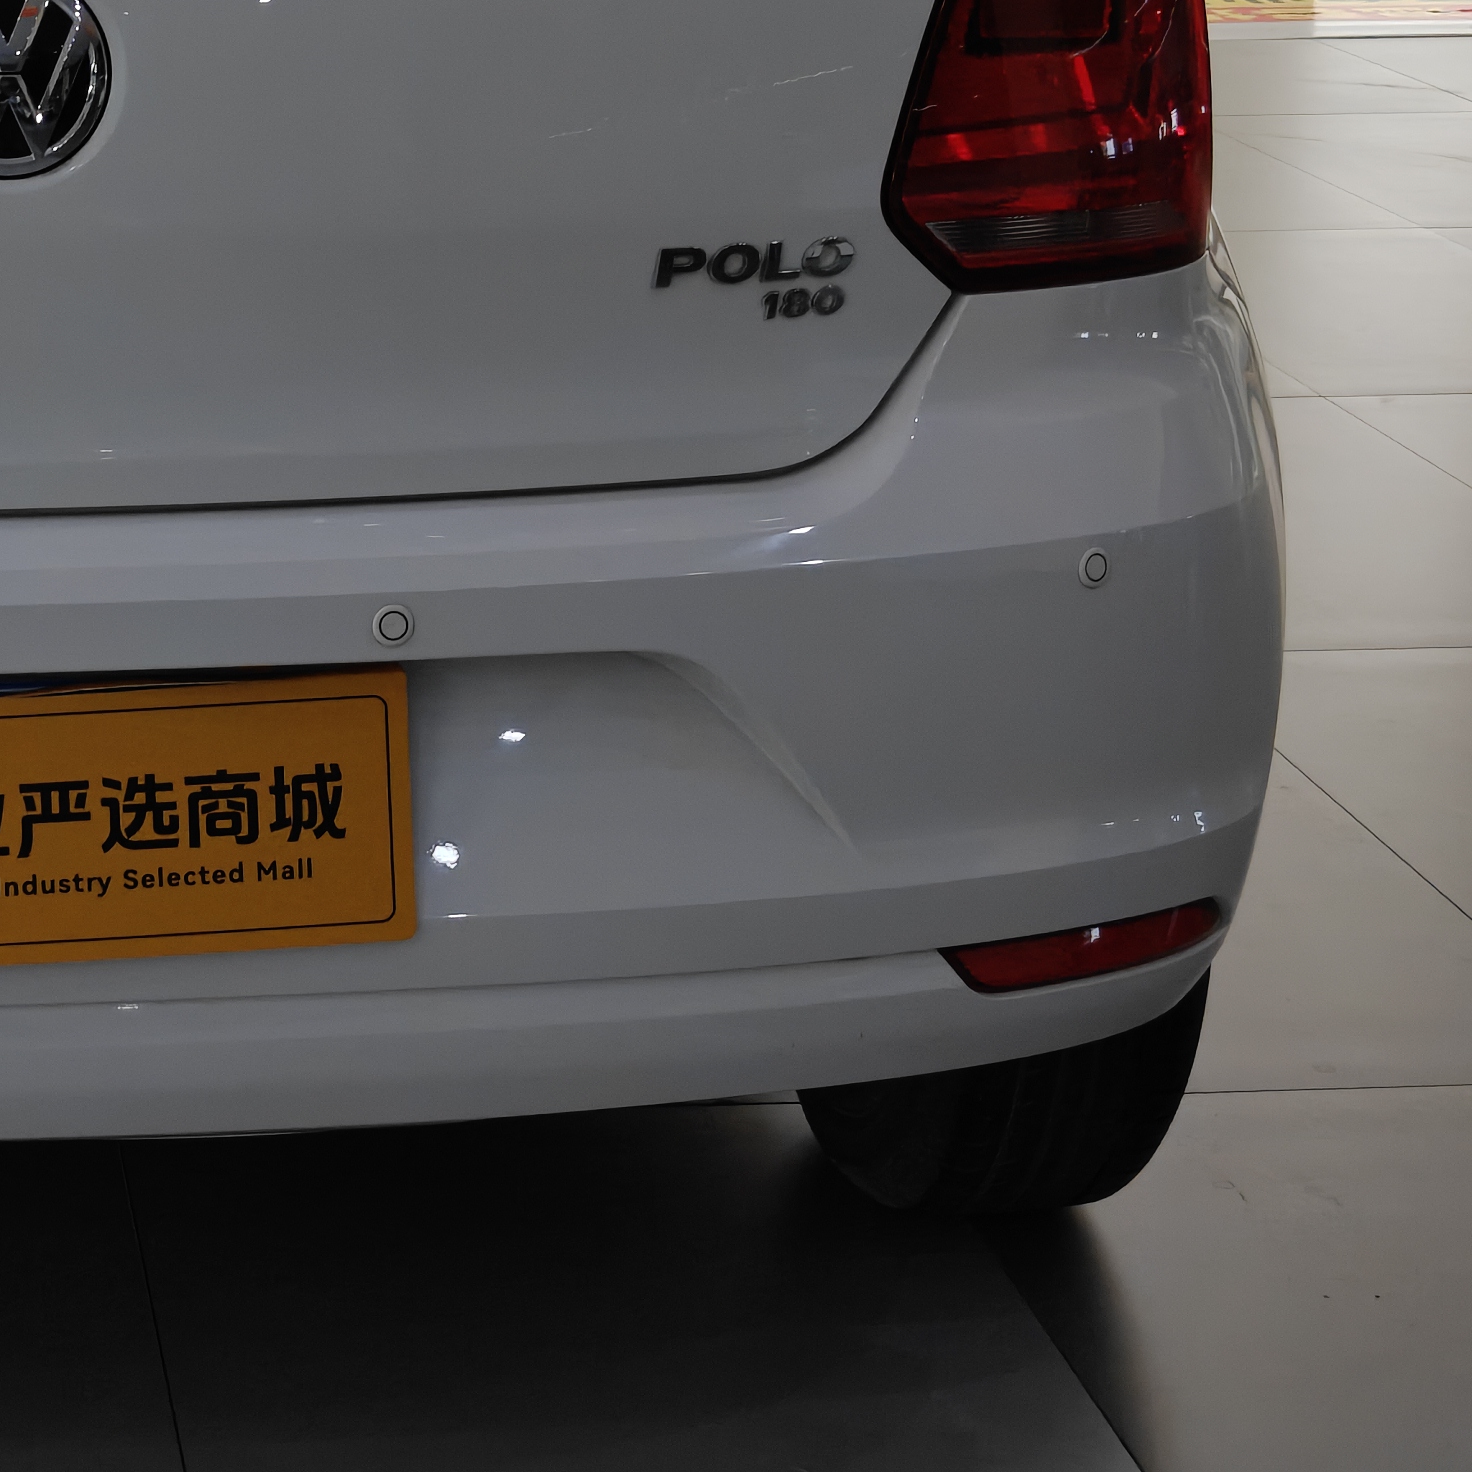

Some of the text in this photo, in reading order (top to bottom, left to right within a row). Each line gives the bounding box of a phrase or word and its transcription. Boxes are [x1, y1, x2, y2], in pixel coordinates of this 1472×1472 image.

[651, 235, 856, 289] POLO
[762, 284, 846, 321] 180
[123, 860, 246, 891] Selected
[256, 857, 314, 884] Mall
